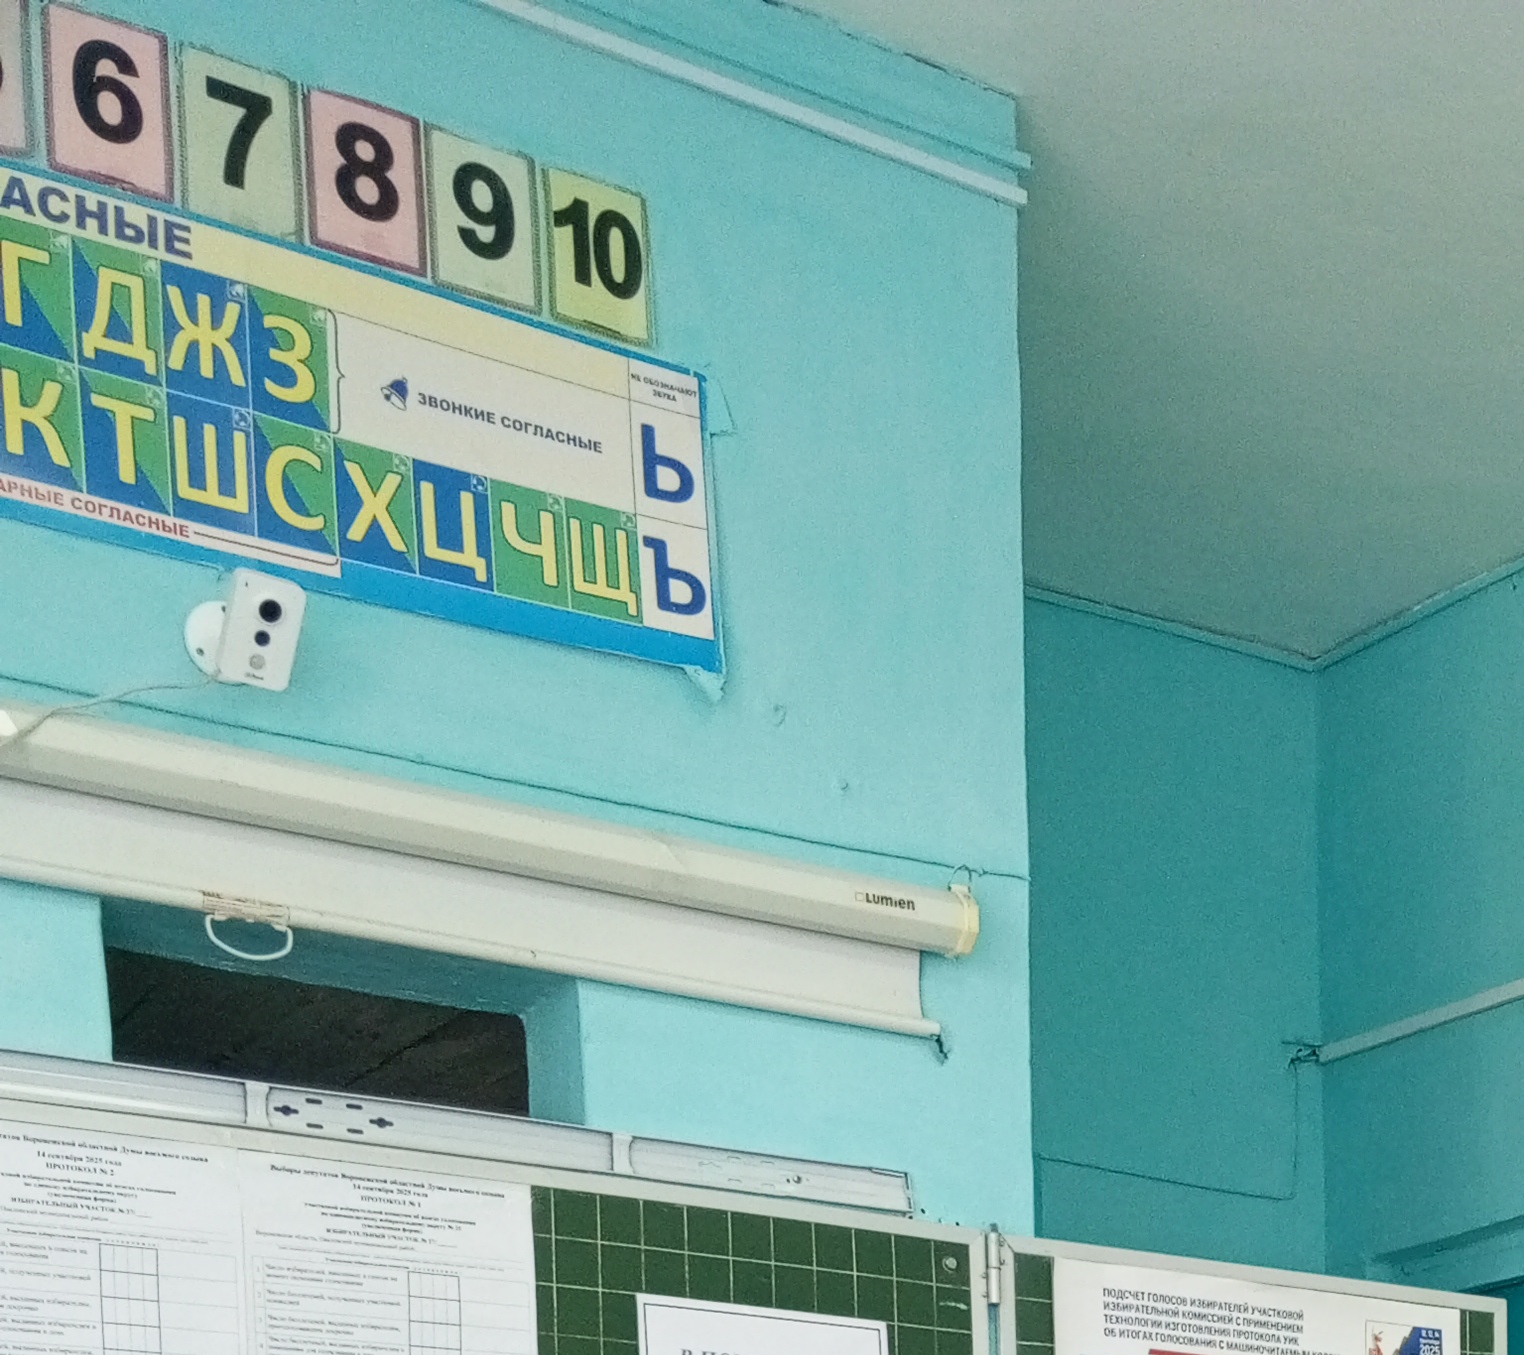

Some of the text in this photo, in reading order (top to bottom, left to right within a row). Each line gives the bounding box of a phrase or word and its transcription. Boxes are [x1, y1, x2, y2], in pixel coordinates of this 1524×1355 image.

[72, 39, 642, 300] 6 7 8 9 10
[0, 175, 193, 260] АСНЫЕ
[1, 239, 316, 403] Г Д Ж З
[417, 392, 603, 454] ЗВОНКИЕ СОГЛАСНЫЕ
[2, 368, 637, 617] К Т Ш С Х Ц Ч Щ
[641, 423, 694, 503] Ь
[71, 497, 190, 538] СОГЛАСНЫЕ
[643, 535, 706, 615] Ъ
[865, 892, 916, 911] Lumien
[1103, 1288, 1304, 1320] ПОДСЧЕТ ГОЛОСОВ ИЗБИРАТЕЛЕЙ УЧАСТКОВОЙ
[1103, 1301, 1304, 1334] ИЗБИРАТЕЛЬНОЙ КОМИССИЕЙ С ПРИМЕНЕНИЕМ
[1104, 1314, 1299, 1346] ТЕХНОЛОГИИ ИЗГОТОВЛЕНИЯ ПРОТОКОЛА УИК
[1104, 1328, 1117, 1337] ОБ
[1119, 1330, 1153, 1341] ИТОГАХ
[1155, 1333, 1217, 1348] ГОЛОСОВАНИЯ
[1219, 1340, 1224, 1349] С
